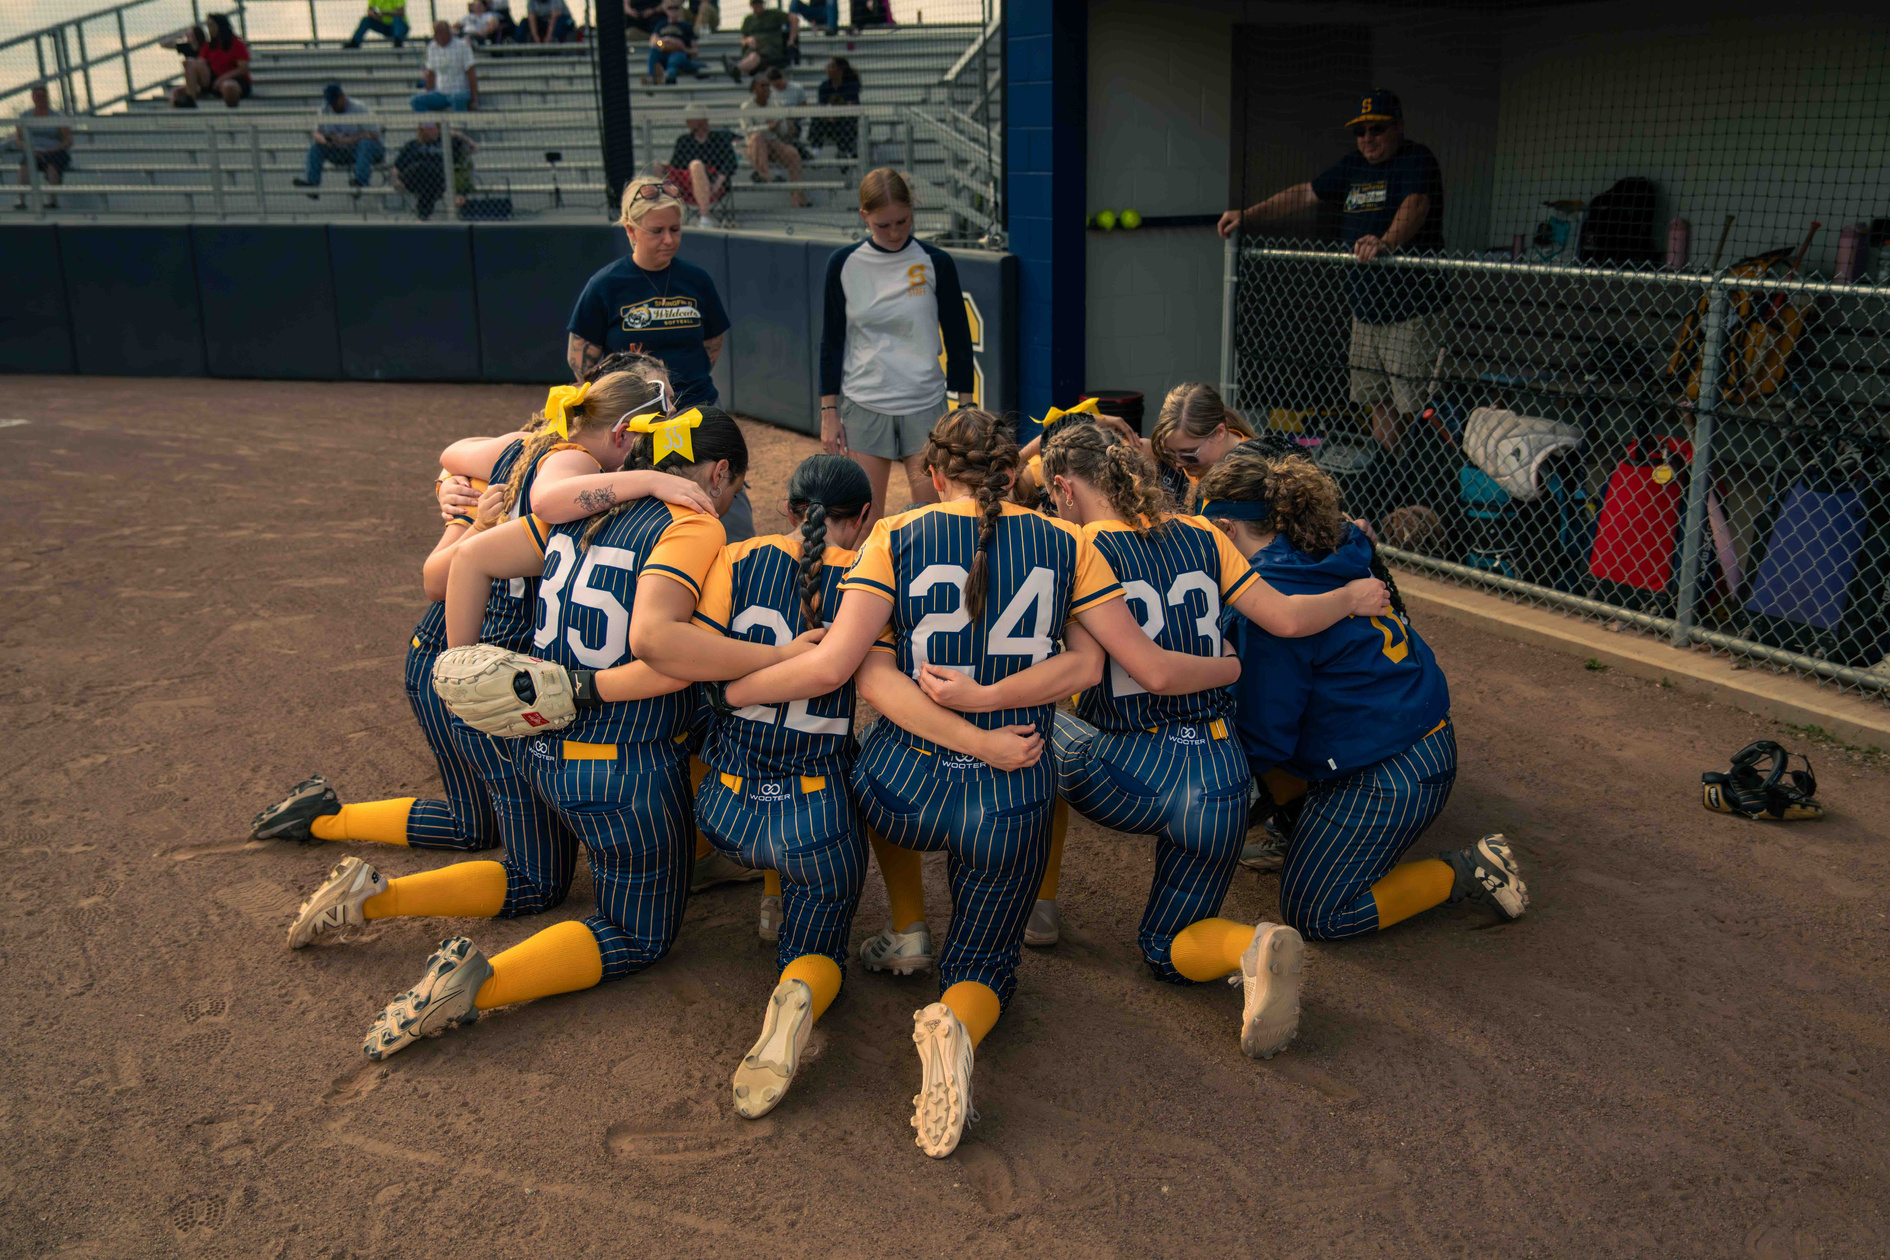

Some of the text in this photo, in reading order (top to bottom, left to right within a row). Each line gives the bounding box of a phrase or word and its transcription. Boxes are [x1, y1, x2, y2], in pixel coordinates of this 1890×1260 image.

[1361, 98, 1372, 113] S
[907, 264, 926, 286] S
[663, 425, 683, 450] 35
[534, 532, 636, 669] 35
[909, 564, 1055, 680] 24
[1168, 734, 1206, 746] WOOTER
[528, 745, 556, 761] WOOTER
[941, 760, 987, 770] WOOTER
[750, 792, 791, 802] WOOTER
